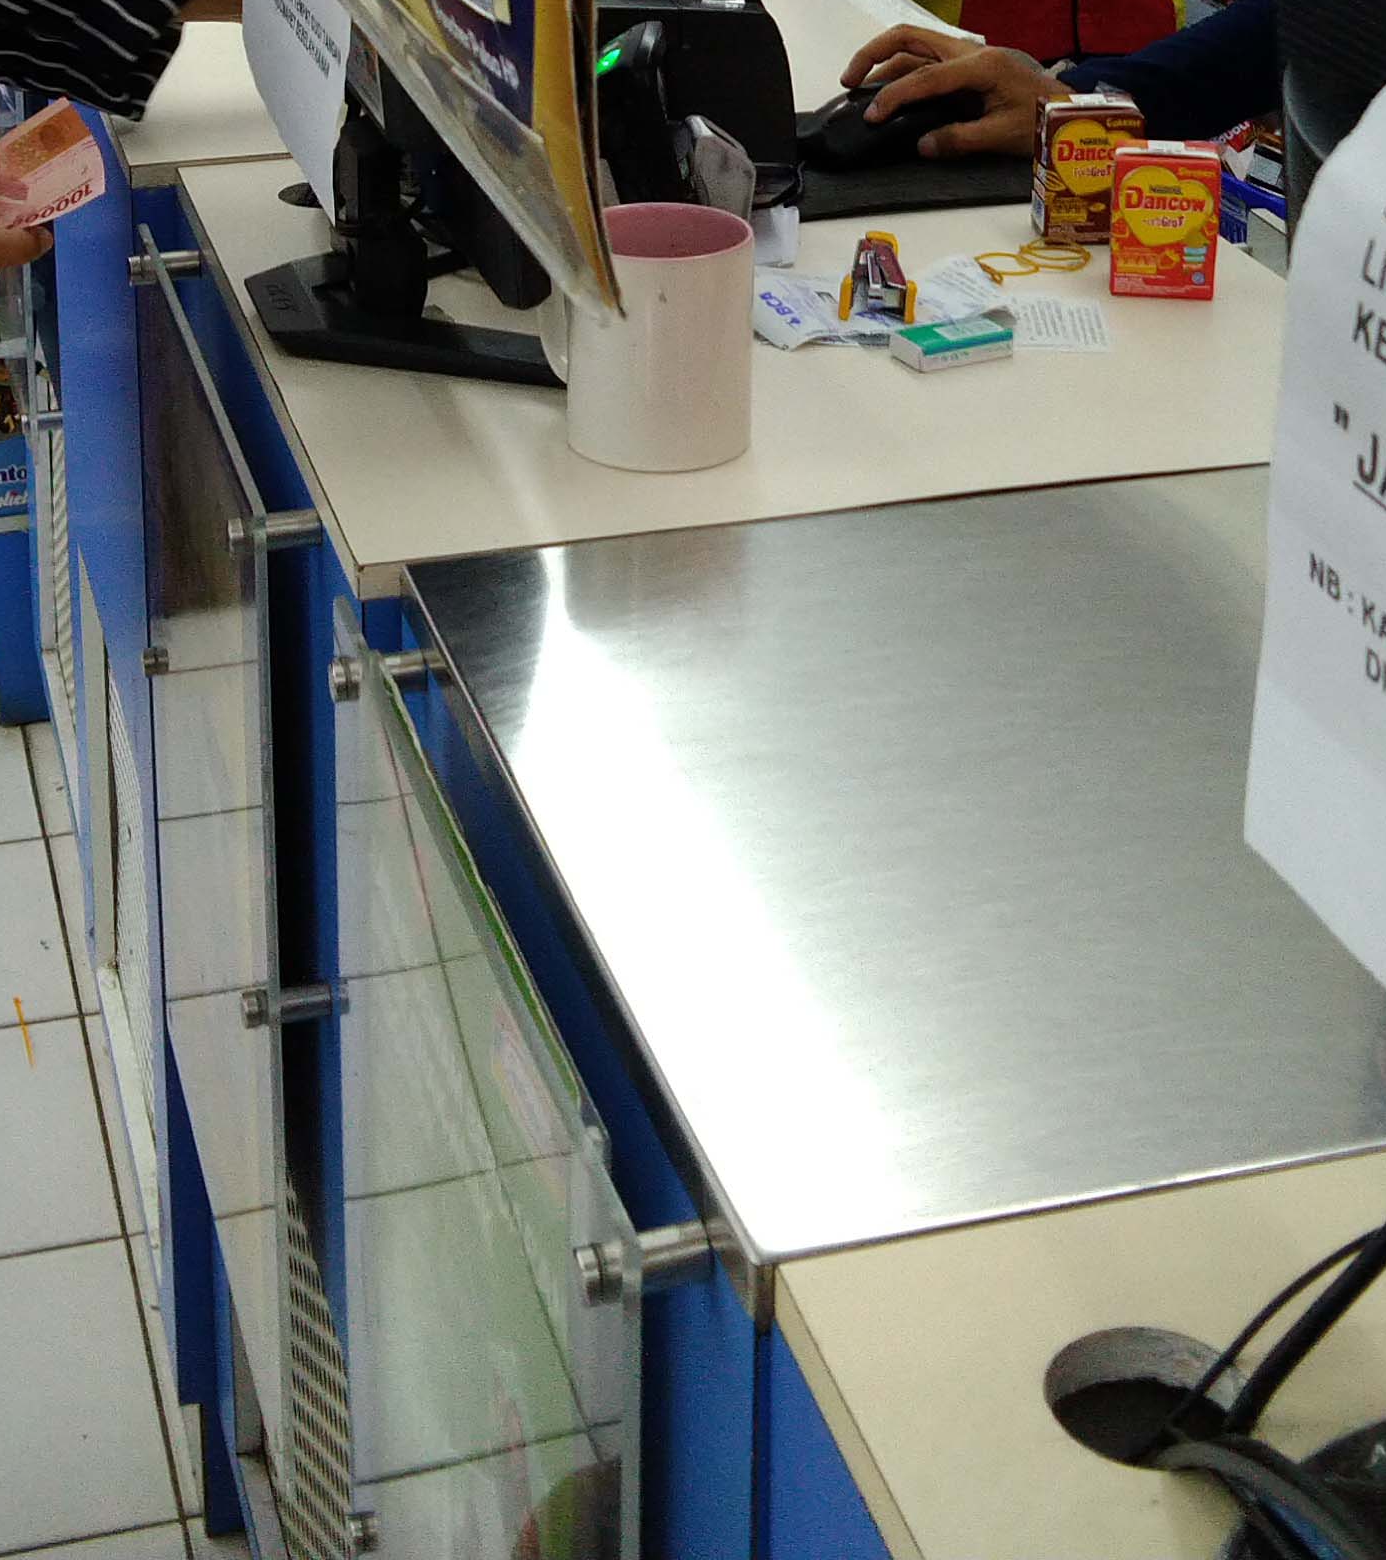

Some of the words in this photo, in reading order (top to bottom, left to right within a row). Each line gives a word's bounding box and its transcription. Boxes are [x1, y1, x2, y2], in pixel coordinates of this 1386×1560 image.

[1123, 185, 1207, 213] Dancow
[759, 290, 794, 317] BCA
[1309, 552, 1343, 603] NB
